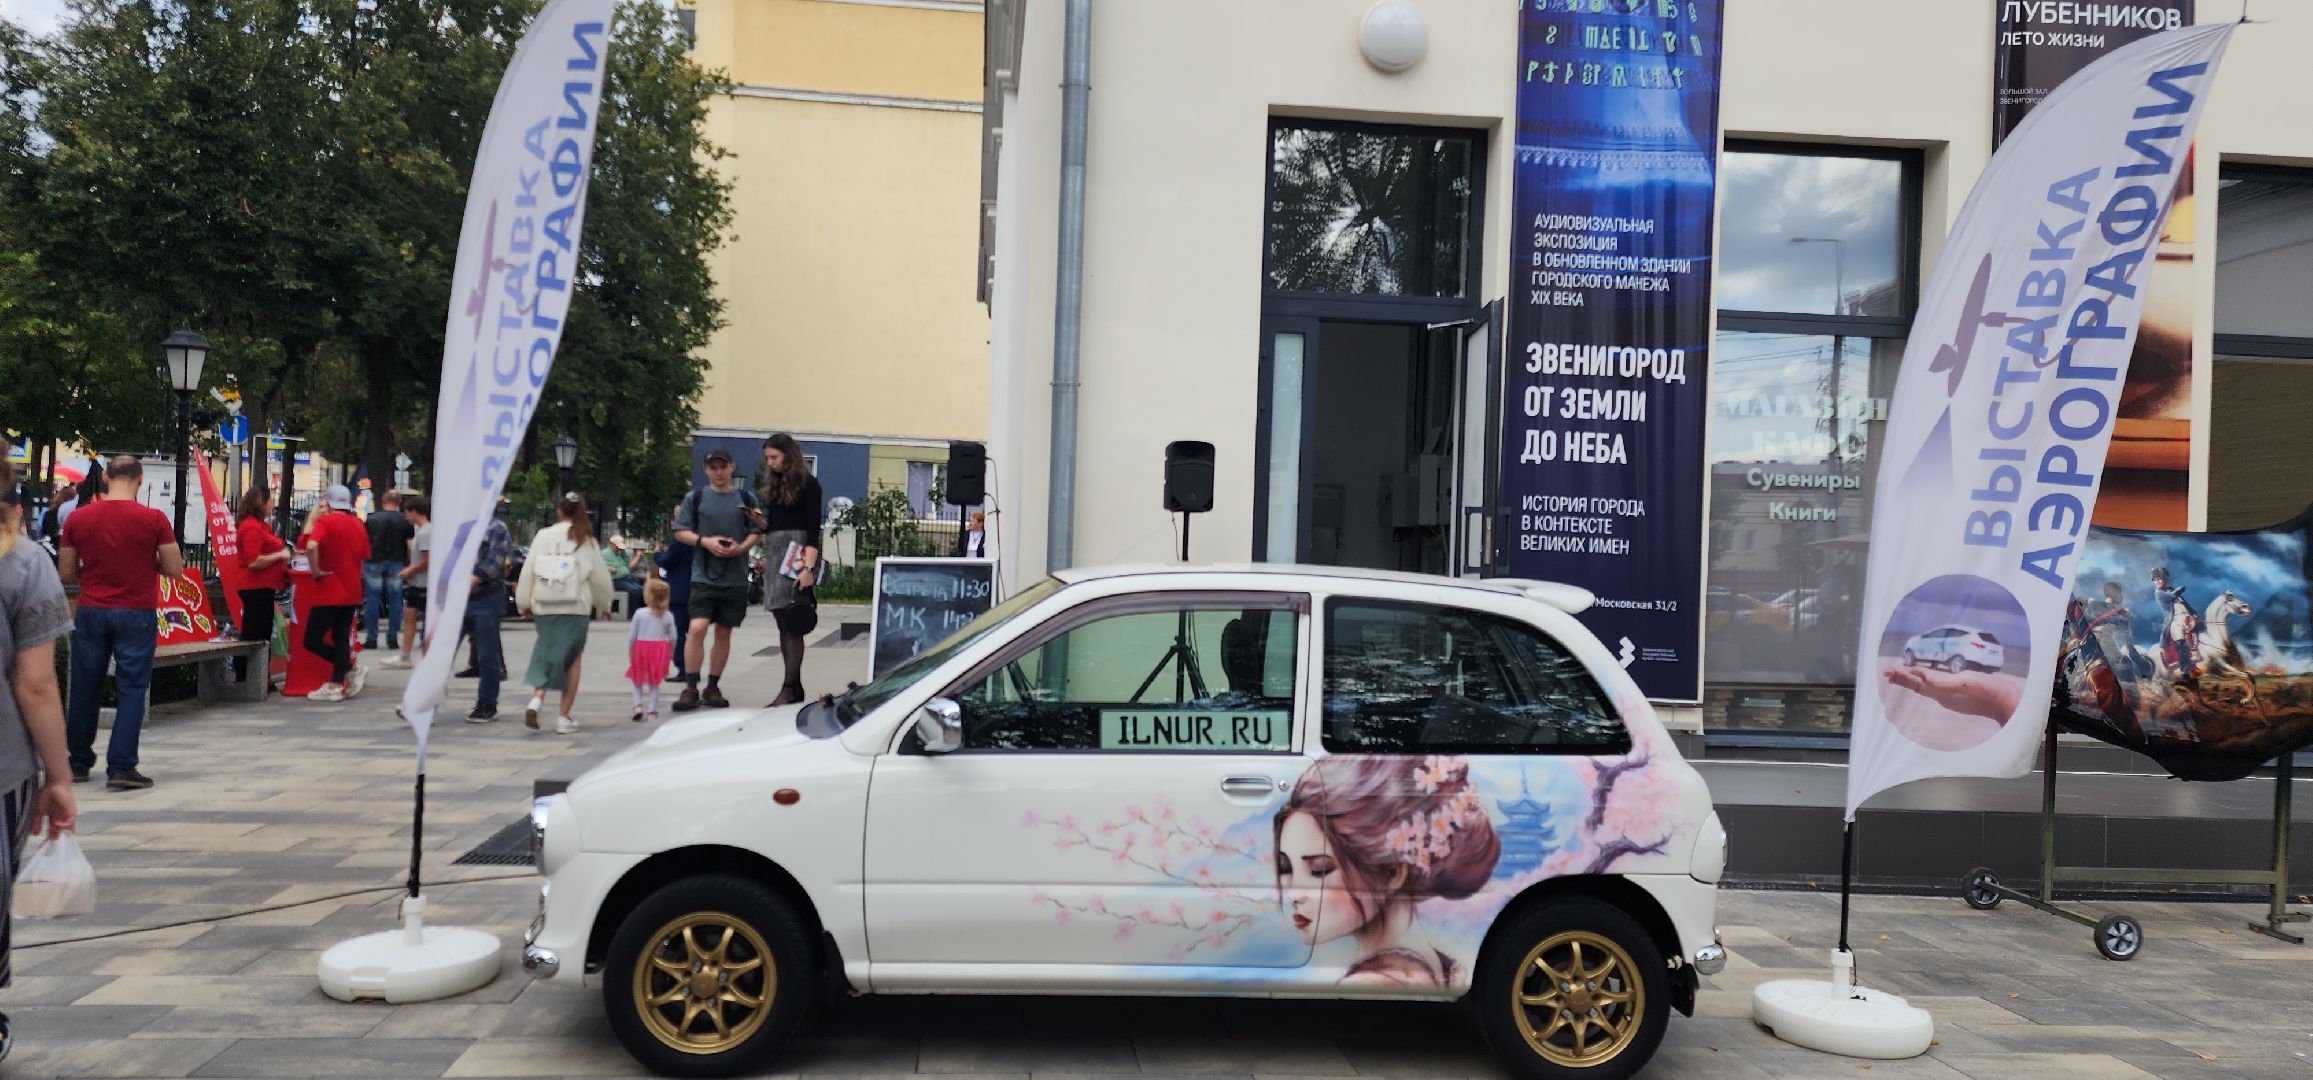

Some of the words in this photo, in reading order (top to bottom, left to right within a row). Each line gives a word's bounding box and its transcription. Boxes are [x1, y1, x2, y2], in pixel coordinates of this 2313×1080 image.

[2002, 1, 2182, 31] ЛУБЕННИКОВ
[2000, 31, 2045, 46] ЛЕТО
[2048, 32, 2105, 48] ЖИЗНИ
[1534, 213, 1654, 234] АУДИОВИЗУАЛЬНАЯ
[1534, 233, 1618, 251] ЭКСПОЗИЦИЯ
[1533, 252, 1541, 266] В
[1544, 253, 1639, 272] ОБНОВЛЕННОМ
[1640, 258, 1691, 274] ЗДАНИИ
[1531, 271, 1613, 291] ГОРОДСКОГО
[1615, 275, 1670, 292] МАНЕЖА
[1553, 291, 1584, 307] ВЕКА
[2020, 60, 2209, 590] АЭРОГРАФИИ
[1526, 342, 1686, 385] ЗВЕНИГОРОД
[1963, 166, 2101, 549] ВЫСТАВКА
[1524, 386, 1555, 417] ОТ
[1560, 388, 1647, 422] ЗЕМЛИ
[1520, 430, 1557, 465] ДО
[1564, 431, 1628, 465] НЕБА
[1747, 467, 1861, 493] Сувениры
[1522, 495, 1588, 513] ИСТОРИЯ
[1591, 498, 1646, 517] ГОРОДА
[1769, 502, 1837, 521] Книги
[1521, 515, 1531, 530] В
[1534, 516, 1613, 535] КОНТЕКСТЕ
[1520, 535, 1585, 553] ВЕЛИКИХ
[1588, 537, 1630, 555] ИМЕН
[952, 578, 990, 599] 11:30
[1595, 597, 1652, 609] Московская
[1655, 600, 1677, 612] 31/2
[1118, 716, 1272, 745] ILNUR.RU
